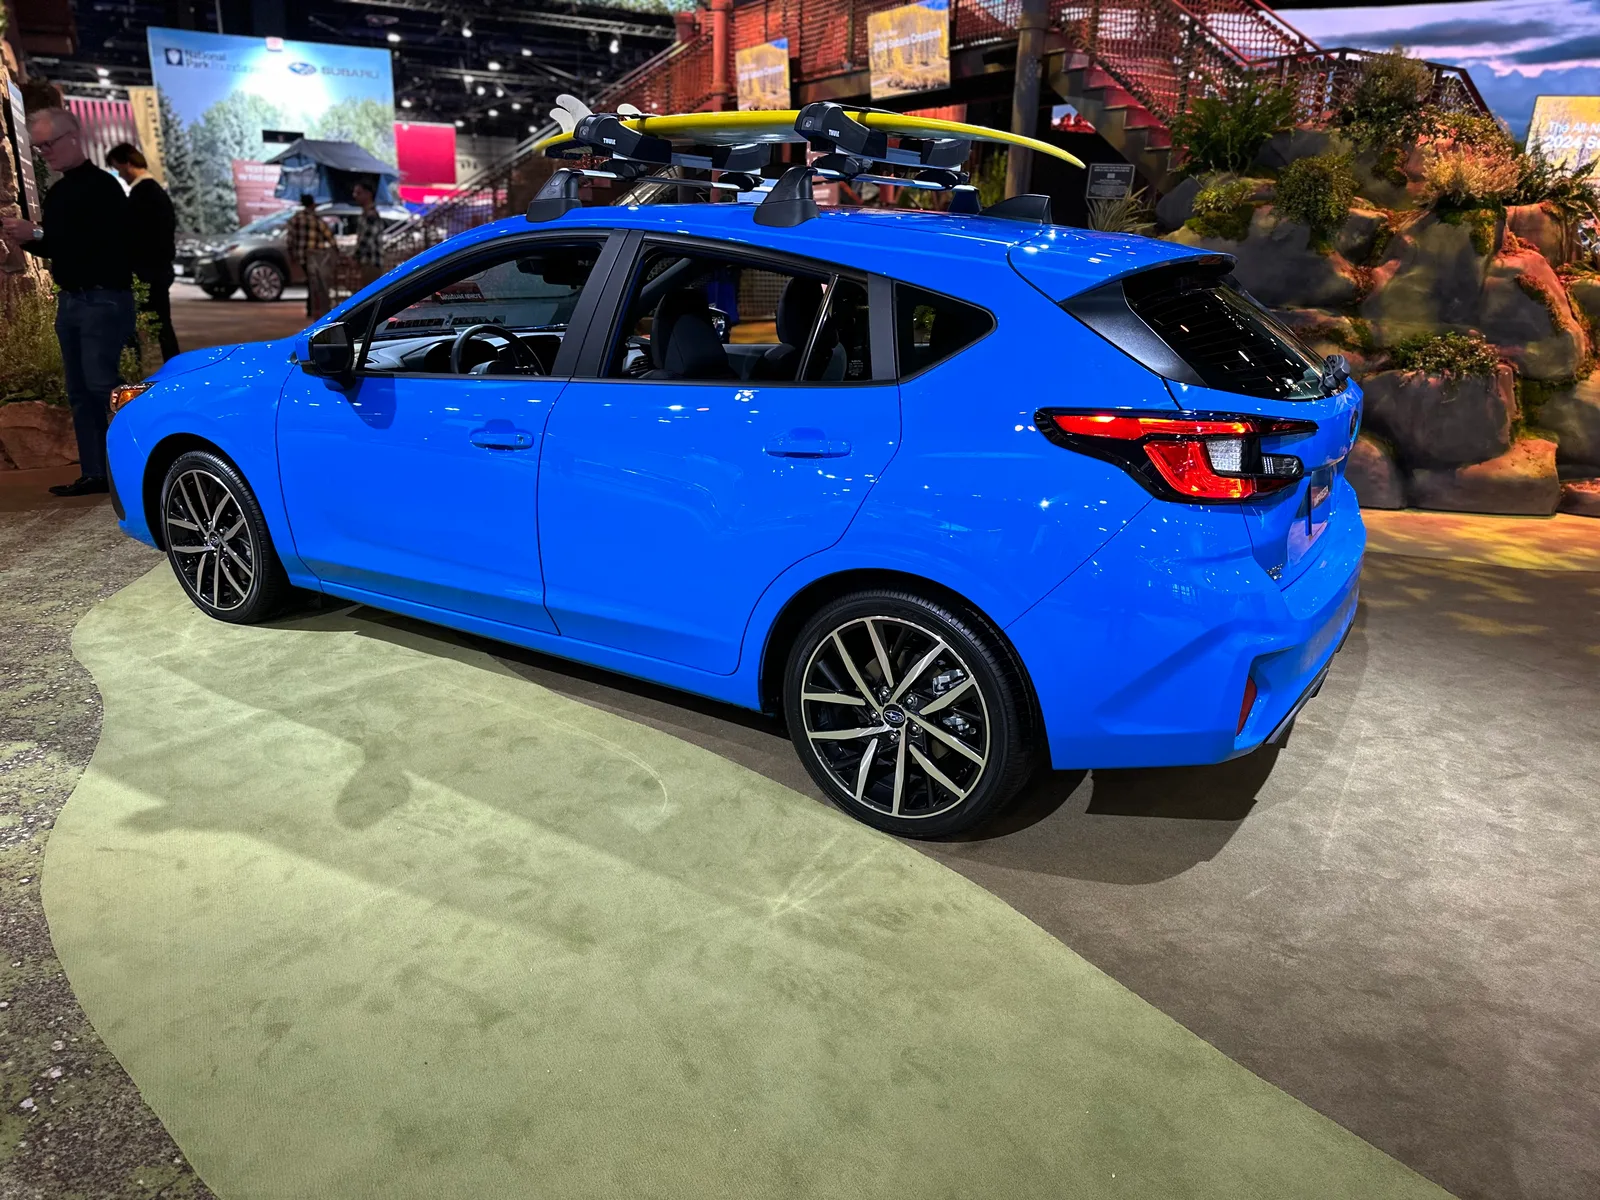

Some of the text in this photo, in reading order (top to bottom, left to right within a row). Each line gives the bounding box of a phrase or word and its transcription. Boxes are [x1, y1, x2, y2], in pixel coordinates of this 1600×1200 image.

[185, 49, 226, 61] National
[185, 59, 209, 69] Park
[321, 66, 379, 80] SUBARU
[828, 129, 840, 138] THULE
[1547, 121, 1570, 137] The
[603, 137, 616, 145] THULE
[1540, 135, 1583, 149] 2024
